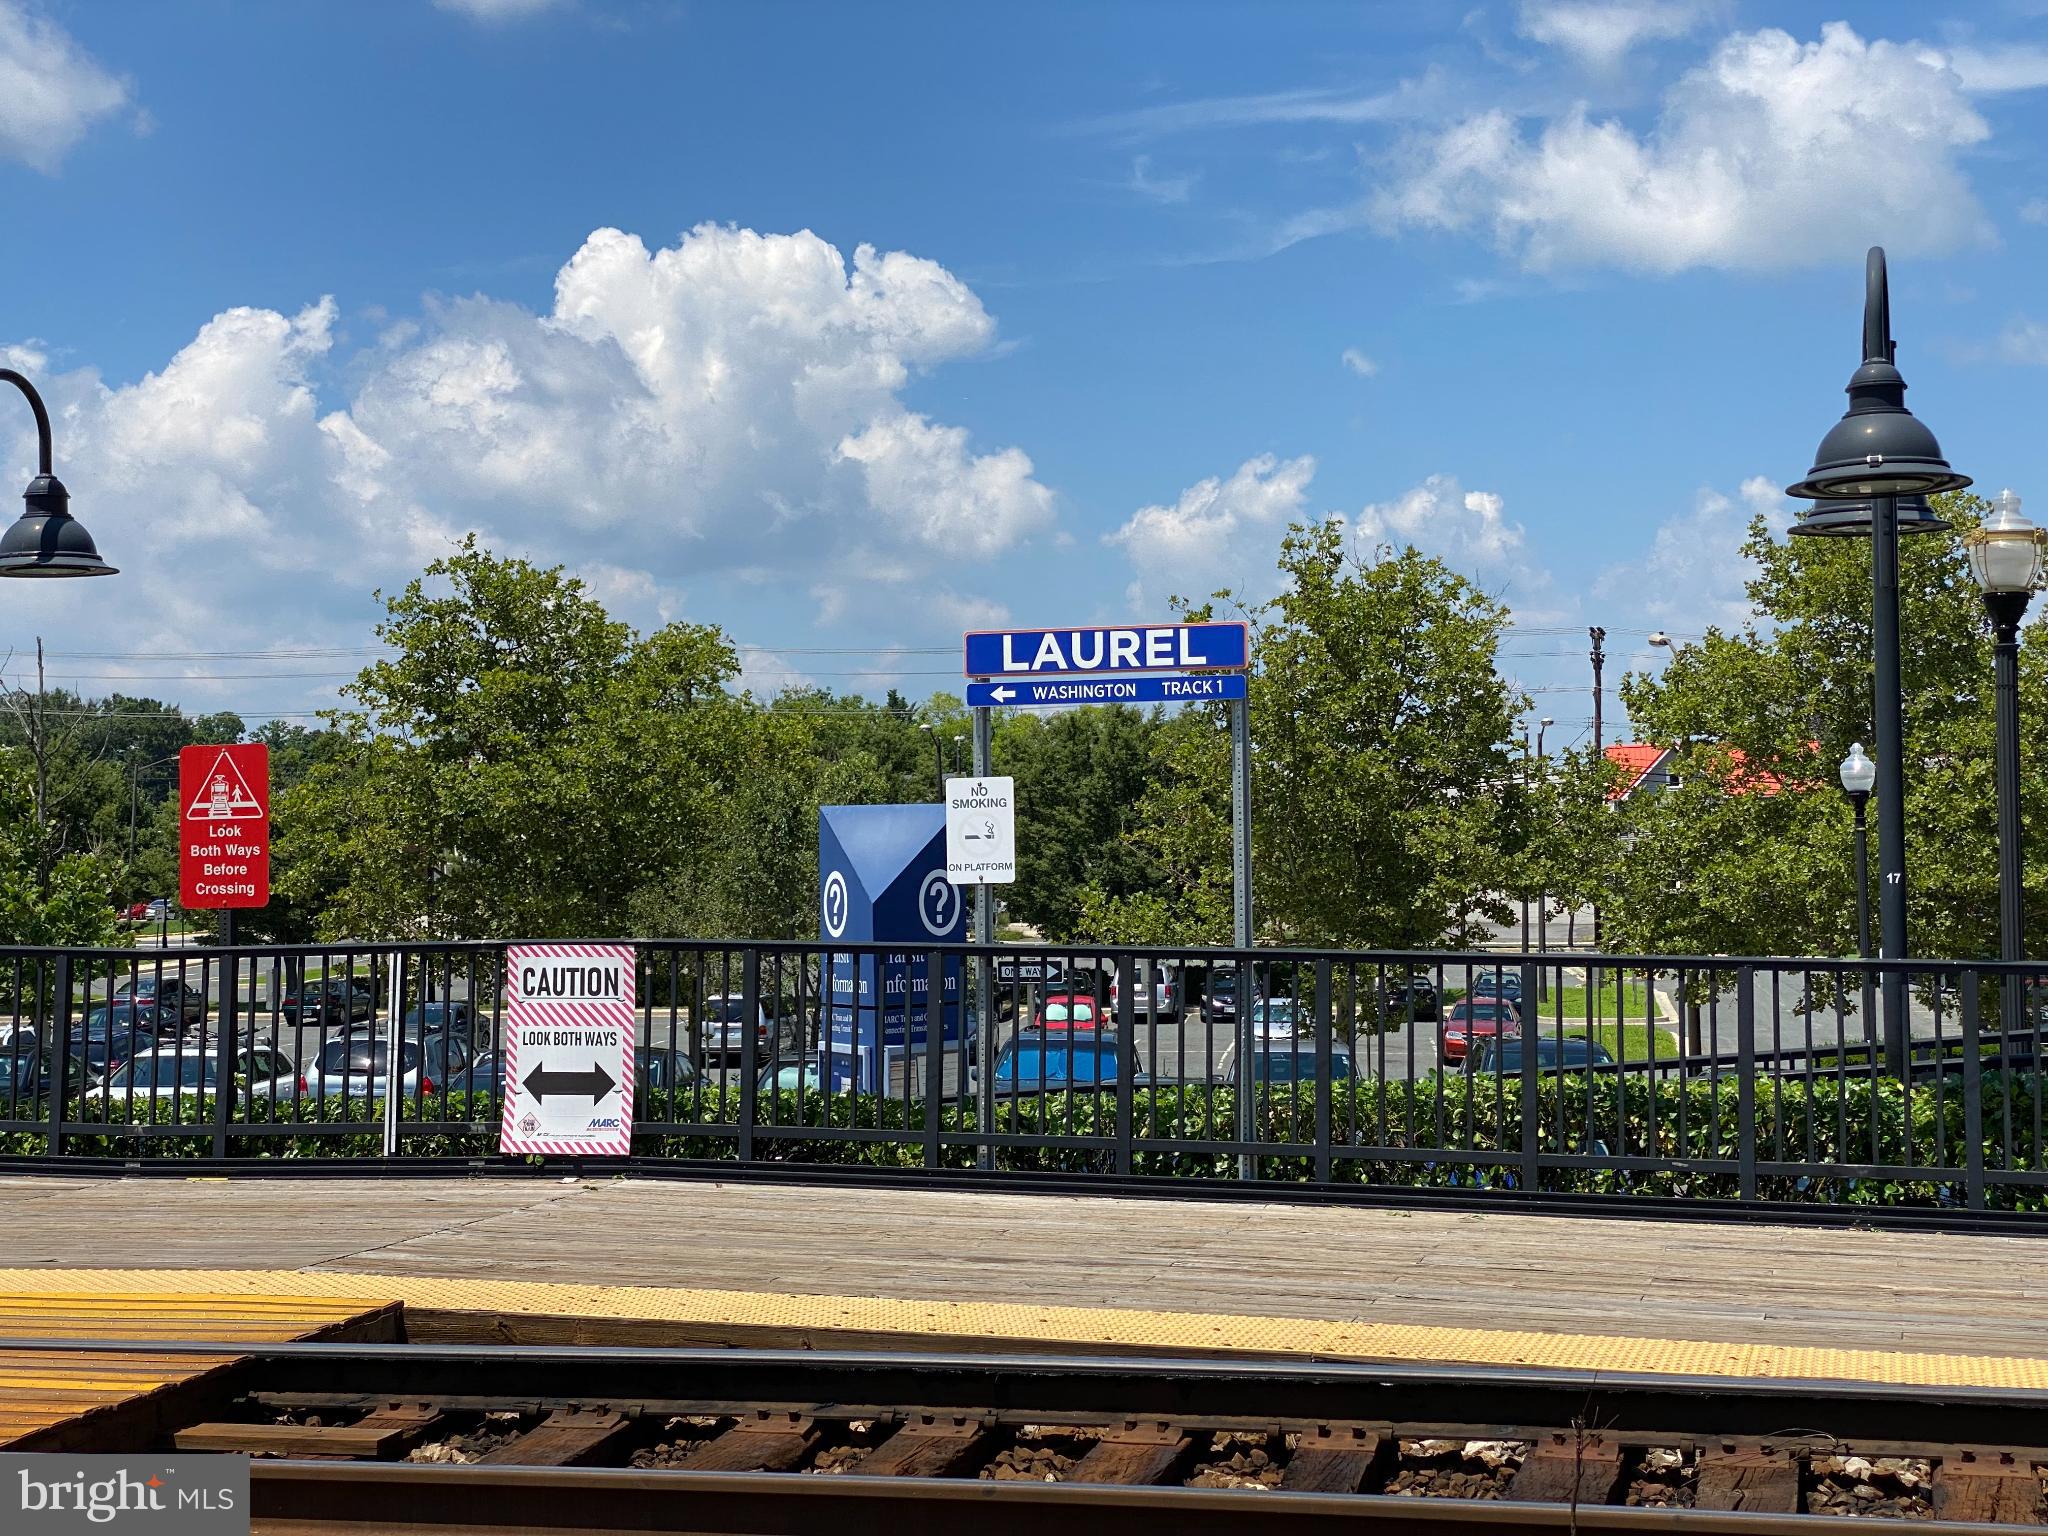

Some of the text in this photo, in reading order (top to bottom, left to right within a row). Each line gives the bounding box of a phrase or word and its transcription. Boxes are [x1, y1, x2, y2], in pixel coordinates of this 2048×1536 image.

[1003, 628, 1207, 671] LAUREL
[1032, 679, 1223, 700] WASHINGTON TRACK 1
[971, 787, 988, 796] NO
[952, 798, 1007, 809] SMOKING
[209, 825, 242, 837] Look
[190, 844, 261, 858] Both Ways
[204, 863, 248, 875] Before
[948, 862, 1013, 871] ON PLATFORM
[1886, 872, 1901, 884] 17
[195, 882, 255, 896] Crossing
[522, 967, 619, 996] CAUTION
[522, 1031, 617, 1047] LOOK BOTH WAYS
[588, 1118, 620, 1128] MARC
